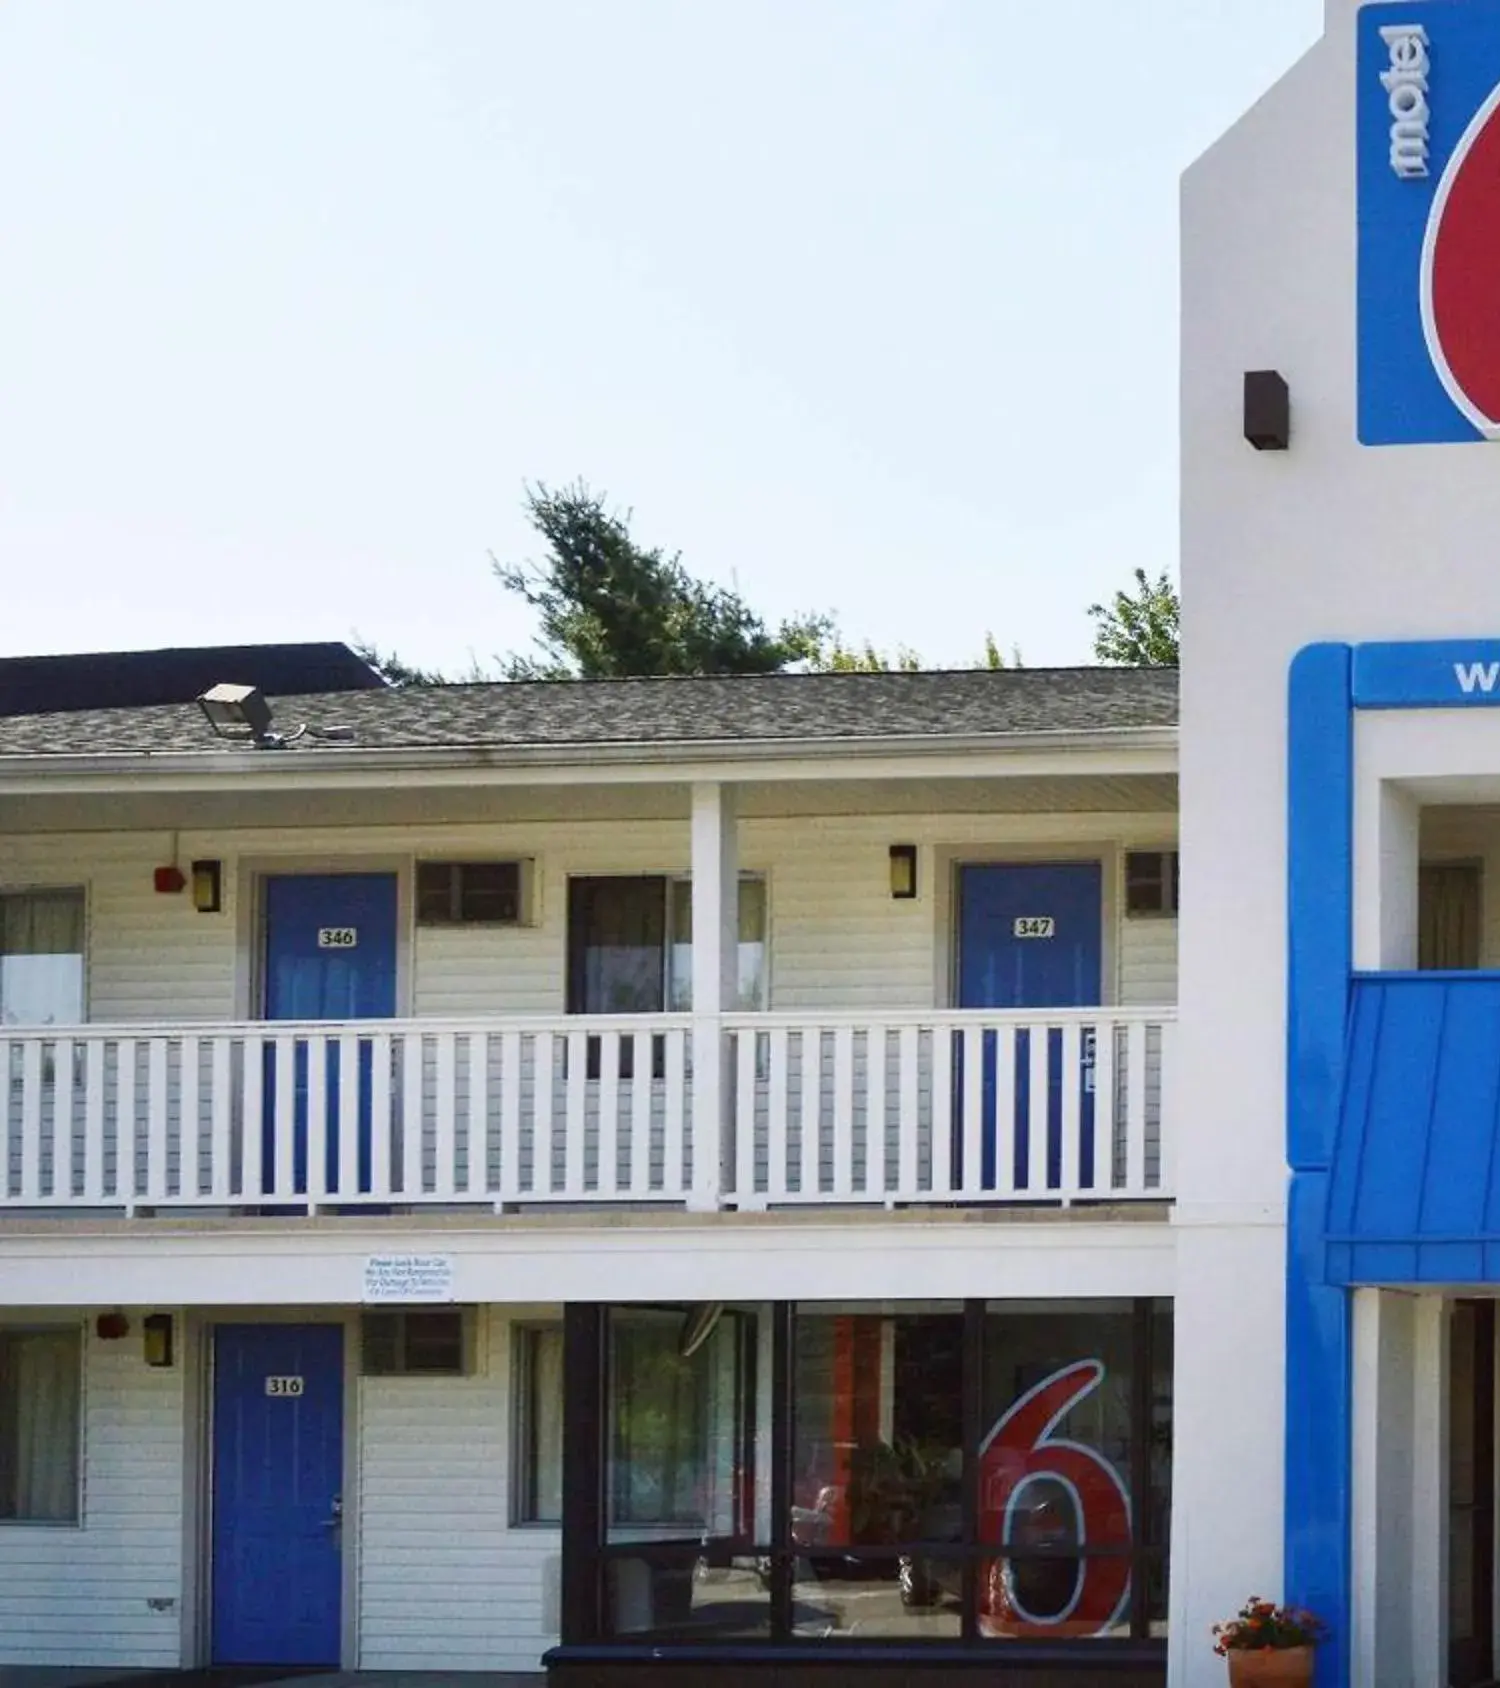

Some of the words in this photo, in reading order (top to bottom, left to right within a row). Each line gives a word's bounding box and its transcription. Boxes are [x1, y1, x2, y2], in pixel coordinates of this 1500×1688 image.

[1379, 25, 1430, 178] motel
[1019, 919, 1050, 935] 347
[322, 931, 353, 945] 346
[269, 1379, 300, 1393] 316
[978, 1359, 1132, 1638] 6
